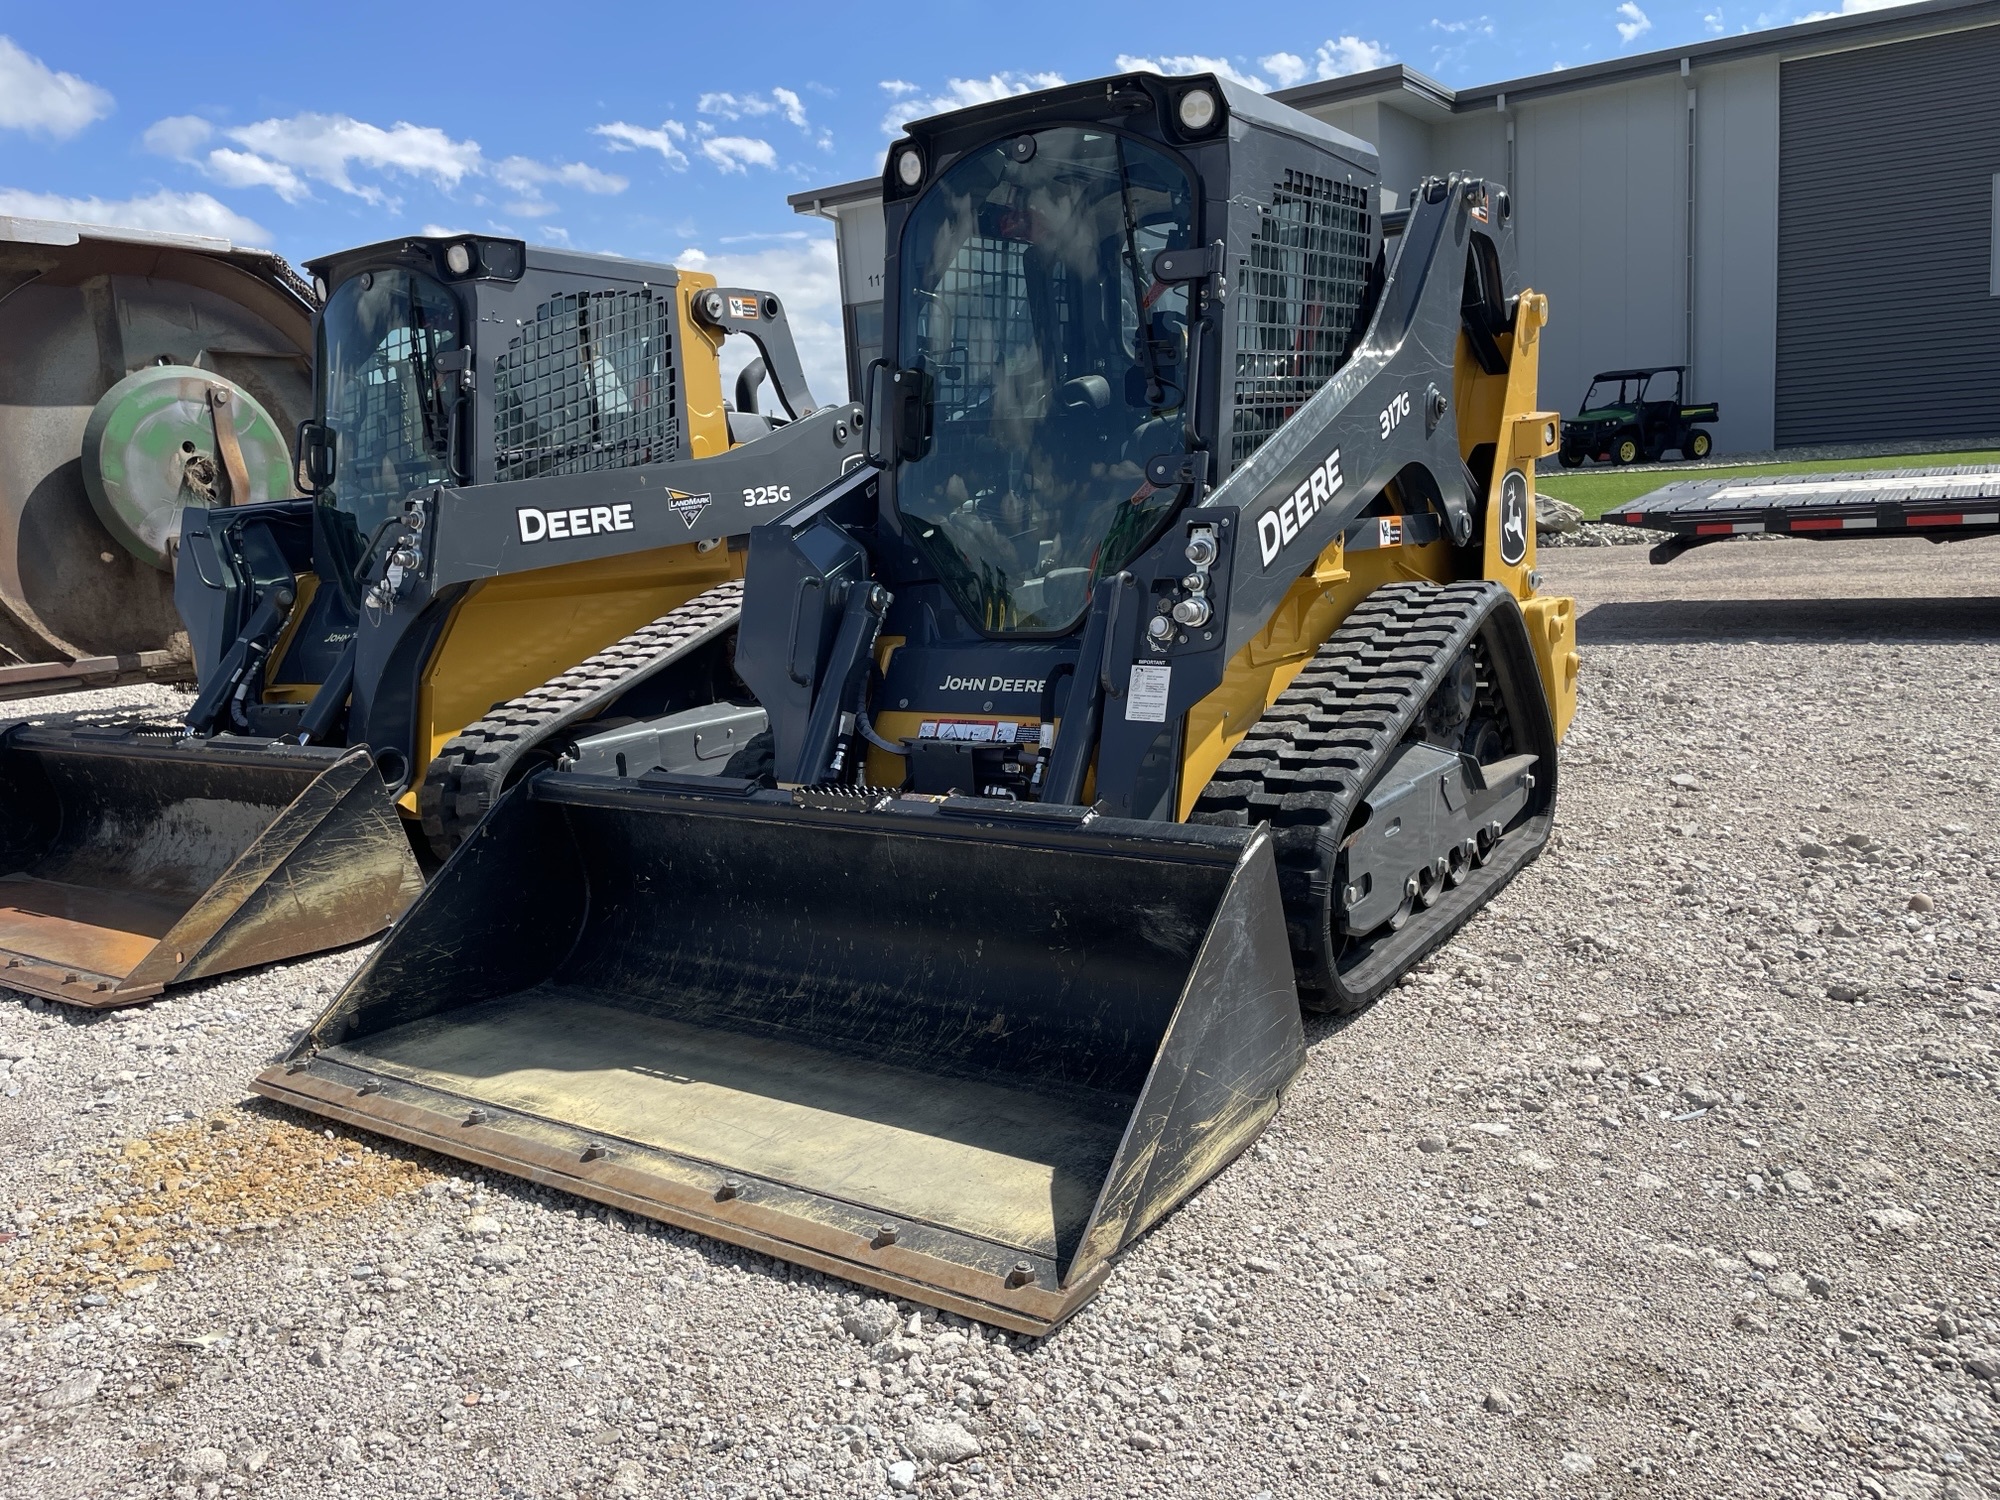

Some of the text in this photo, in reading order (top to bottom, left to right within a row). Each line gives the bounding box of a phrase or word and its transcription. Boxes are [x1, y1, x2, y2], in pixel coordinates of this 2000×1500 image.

[1379, 391, 1410, 440] 317G
[742, 485, 791, 507] 325G
[1257, 448, 1344, 567] DEERE
[518, 503, 634, 543] DEERE
[324, 633, 351, 643] JOHN
[939, 675, 1046, 693] JOHN DEERE
